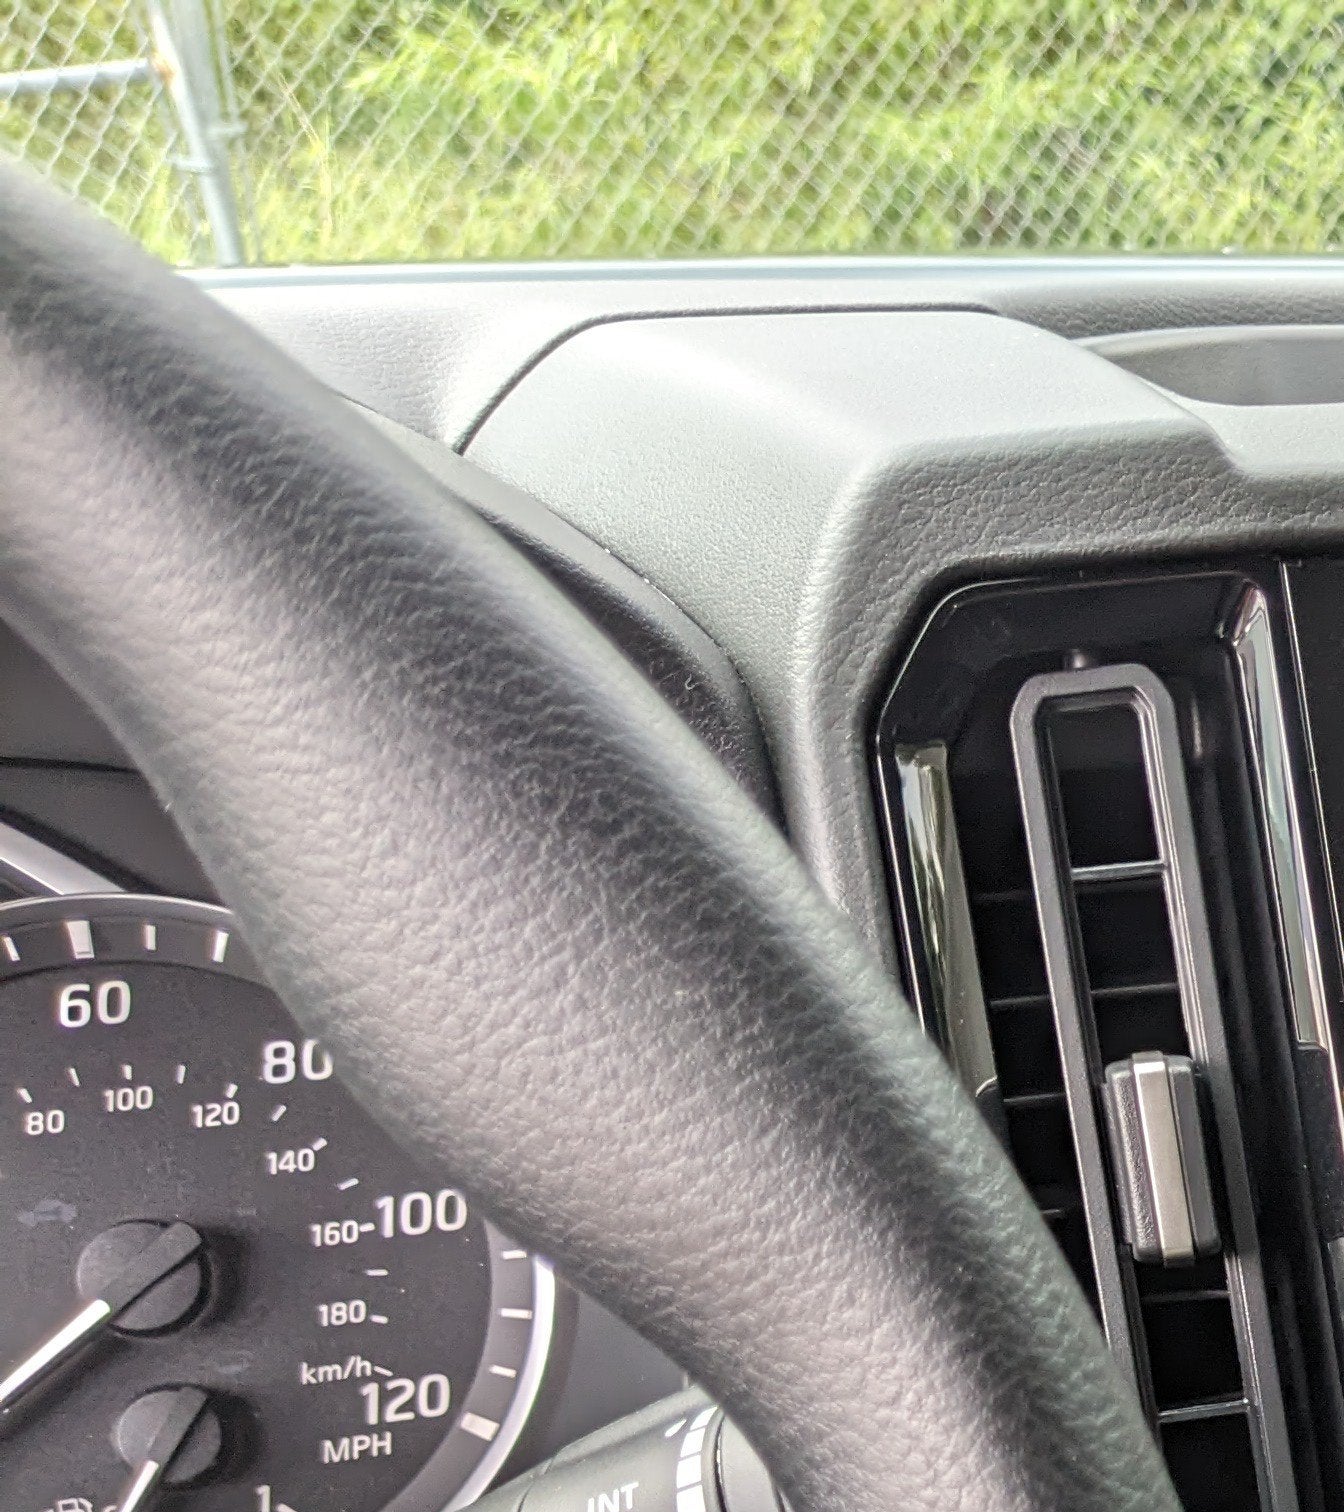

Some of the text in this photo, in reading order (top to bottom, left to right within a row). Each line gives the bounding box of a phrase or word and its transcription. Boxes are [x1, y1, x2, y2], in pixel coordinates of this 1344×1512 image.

[59, 980, 131, 1028] 60
[263, 1039, 334, 1085] 80
[103, 1085, 154, 1112] 100
[24, 1109, 65, 1136] 80
[191, 1101, 240, 1128] 120
[266, 1148, 315, 1175] 140
[376, 1188, 468, 1239] 100
[311, 1219, 359, 1247] 160
[317, 1300, 366, 1327] 180
[300, 1355, 372, 1386] km/h
[360, 1373, 451, 1426] 120
[322, 1431, 392, 1464] MPH
